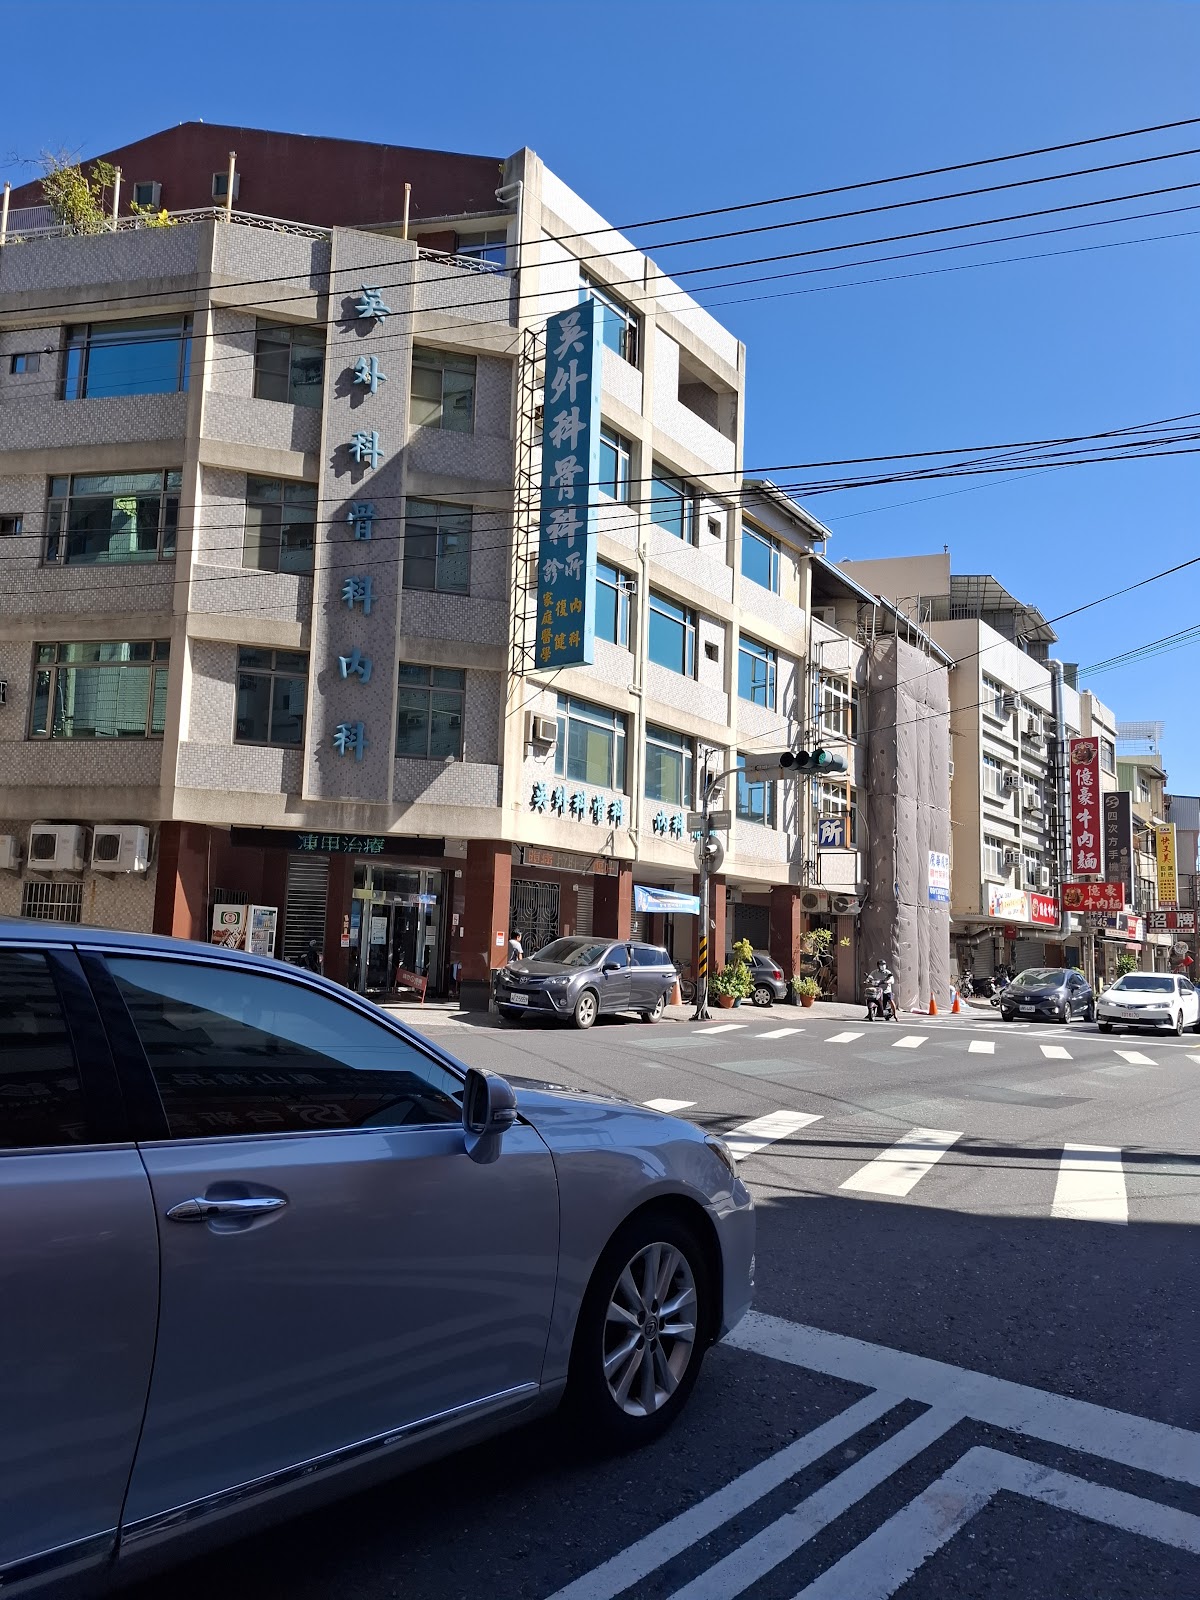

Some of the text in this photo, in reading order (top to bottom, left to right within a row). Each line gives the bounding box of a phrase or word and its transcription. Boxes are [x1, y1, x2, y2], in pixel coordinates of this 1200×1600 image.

[542, 551, 585, 586] 診所
[540, 591, 554, 663] 家庭醫學
[554, 599, 569, 650] 復健
[820, 819, 844, 846] 所
[1076, 767, 1098, 870] 億豪牛肉麵
[1084, 897, 1122, 910] 牛肉麵
[1087, 884, 1117, 897] 億豪
[1149, 911, 1195, 928] 招牌
